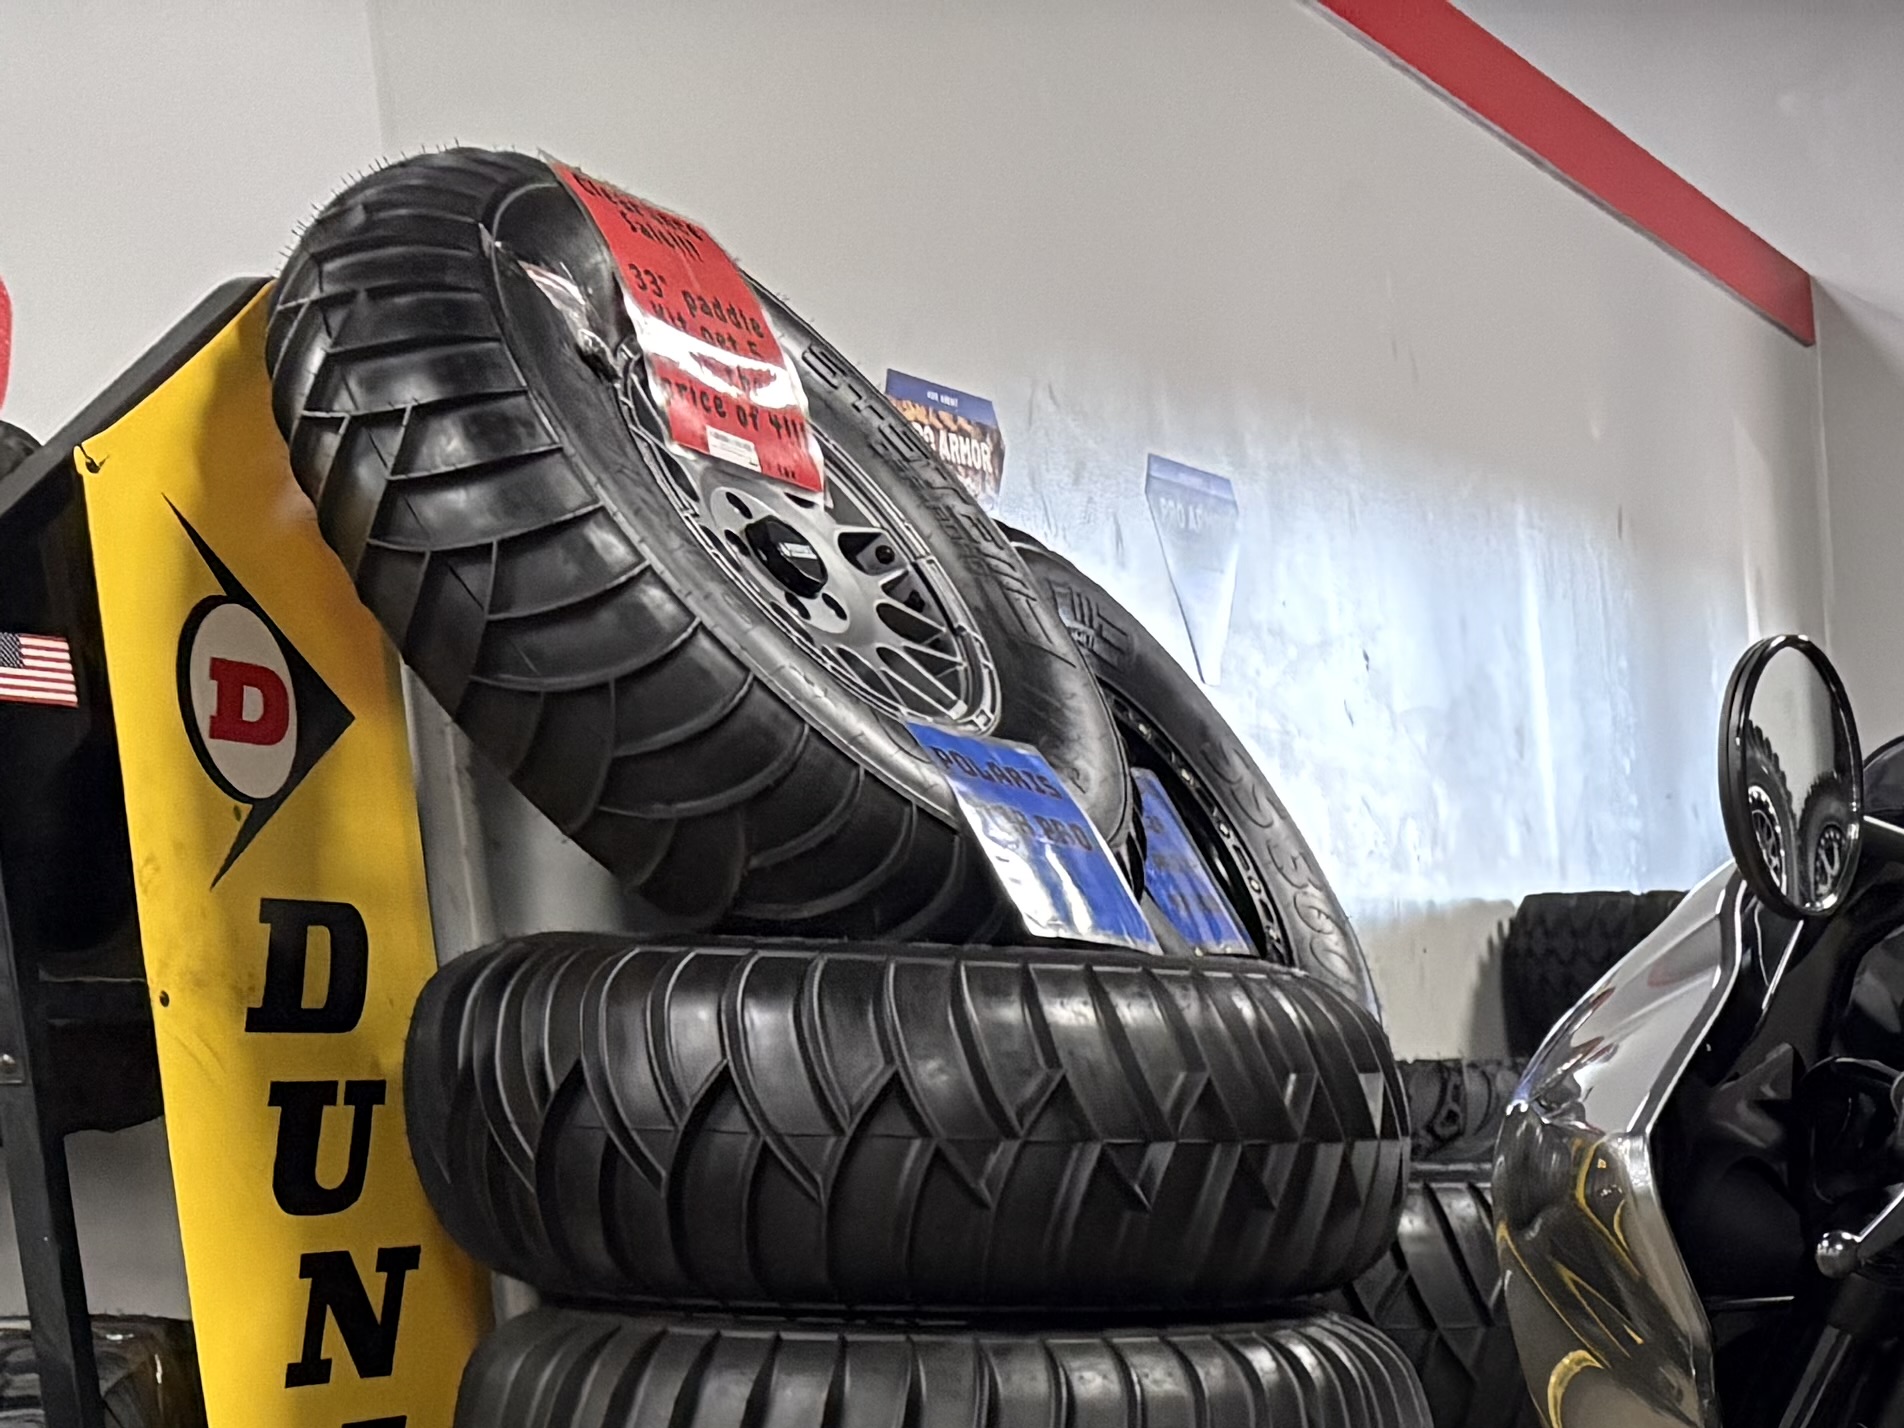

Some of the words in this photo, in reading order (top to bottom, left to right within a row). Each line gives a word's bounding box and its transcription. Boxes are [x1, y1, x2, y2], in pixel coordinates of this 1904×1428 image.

[682, 289, 765, 339] paddle
[939, 429, 993, 474] ARMOR
[208, 657, 291, 746] D
[930, 746, 1064, 800] POLARIS
